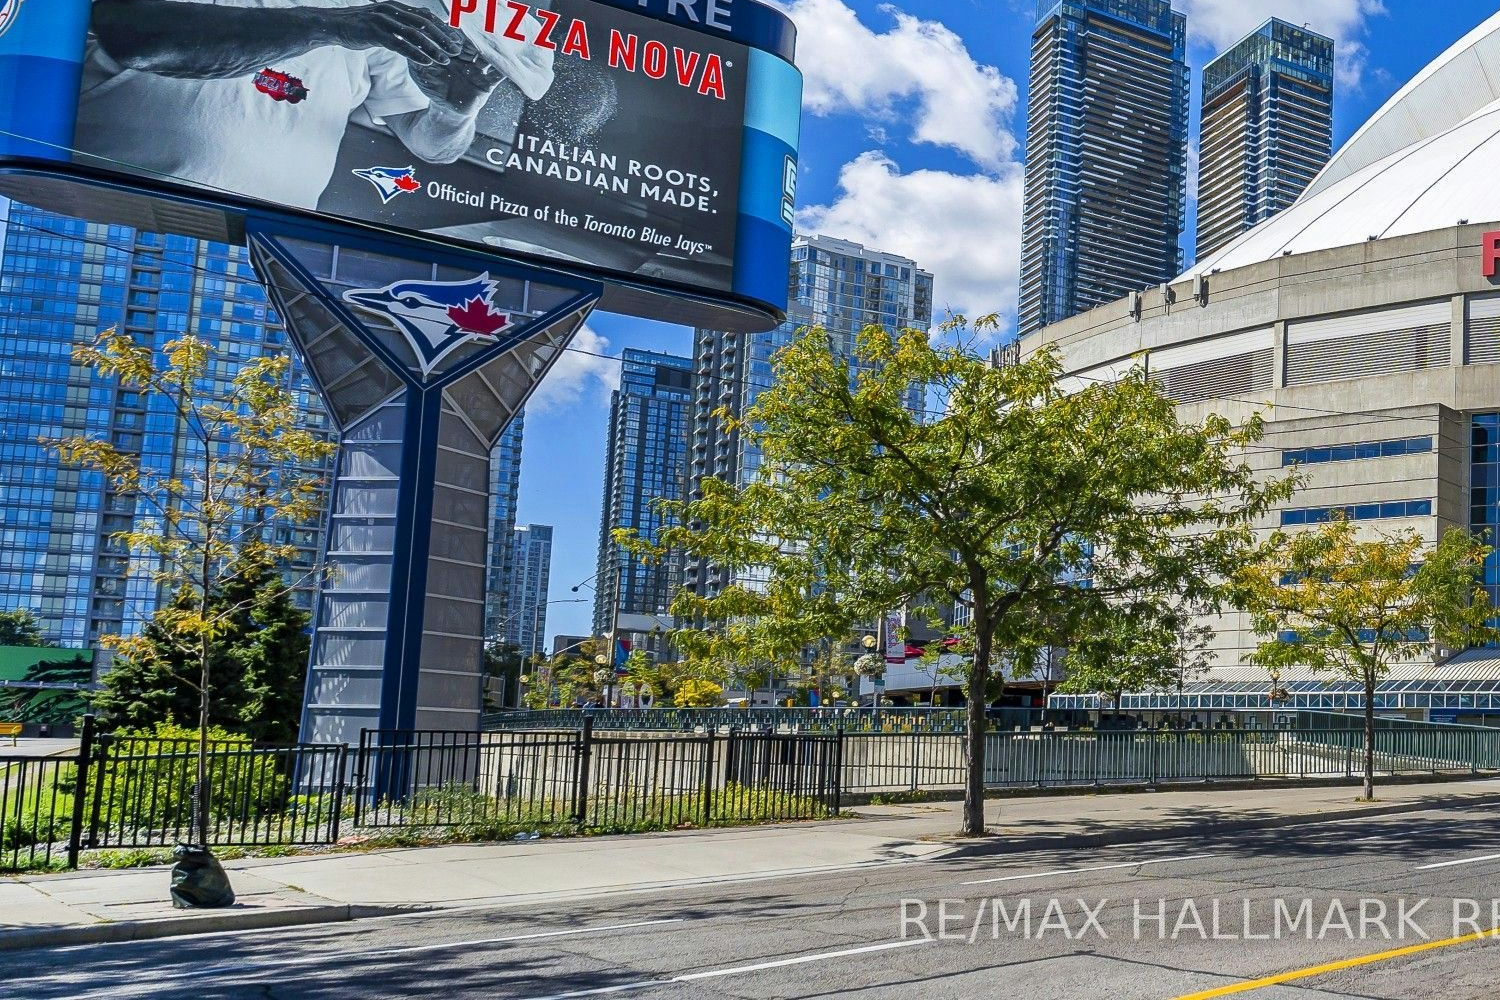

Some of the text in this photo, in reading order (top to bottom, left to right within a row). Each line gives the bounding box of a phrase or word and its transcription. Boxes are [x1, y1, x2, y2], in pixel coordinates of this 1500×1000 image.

[486, 149, 718, 214] CANADIAN MADE.
[517, 133, 719, 197] ITALIAN ROOTS,
[427, 181, 485, 208] Official
[490, 197, 529, 218] Pizza
[534, 206, 549, 221] of
[555, 208, 579, 228] the
[584, 214, 636, 241] Toronto
[640, 226, 672, 247] Blue
